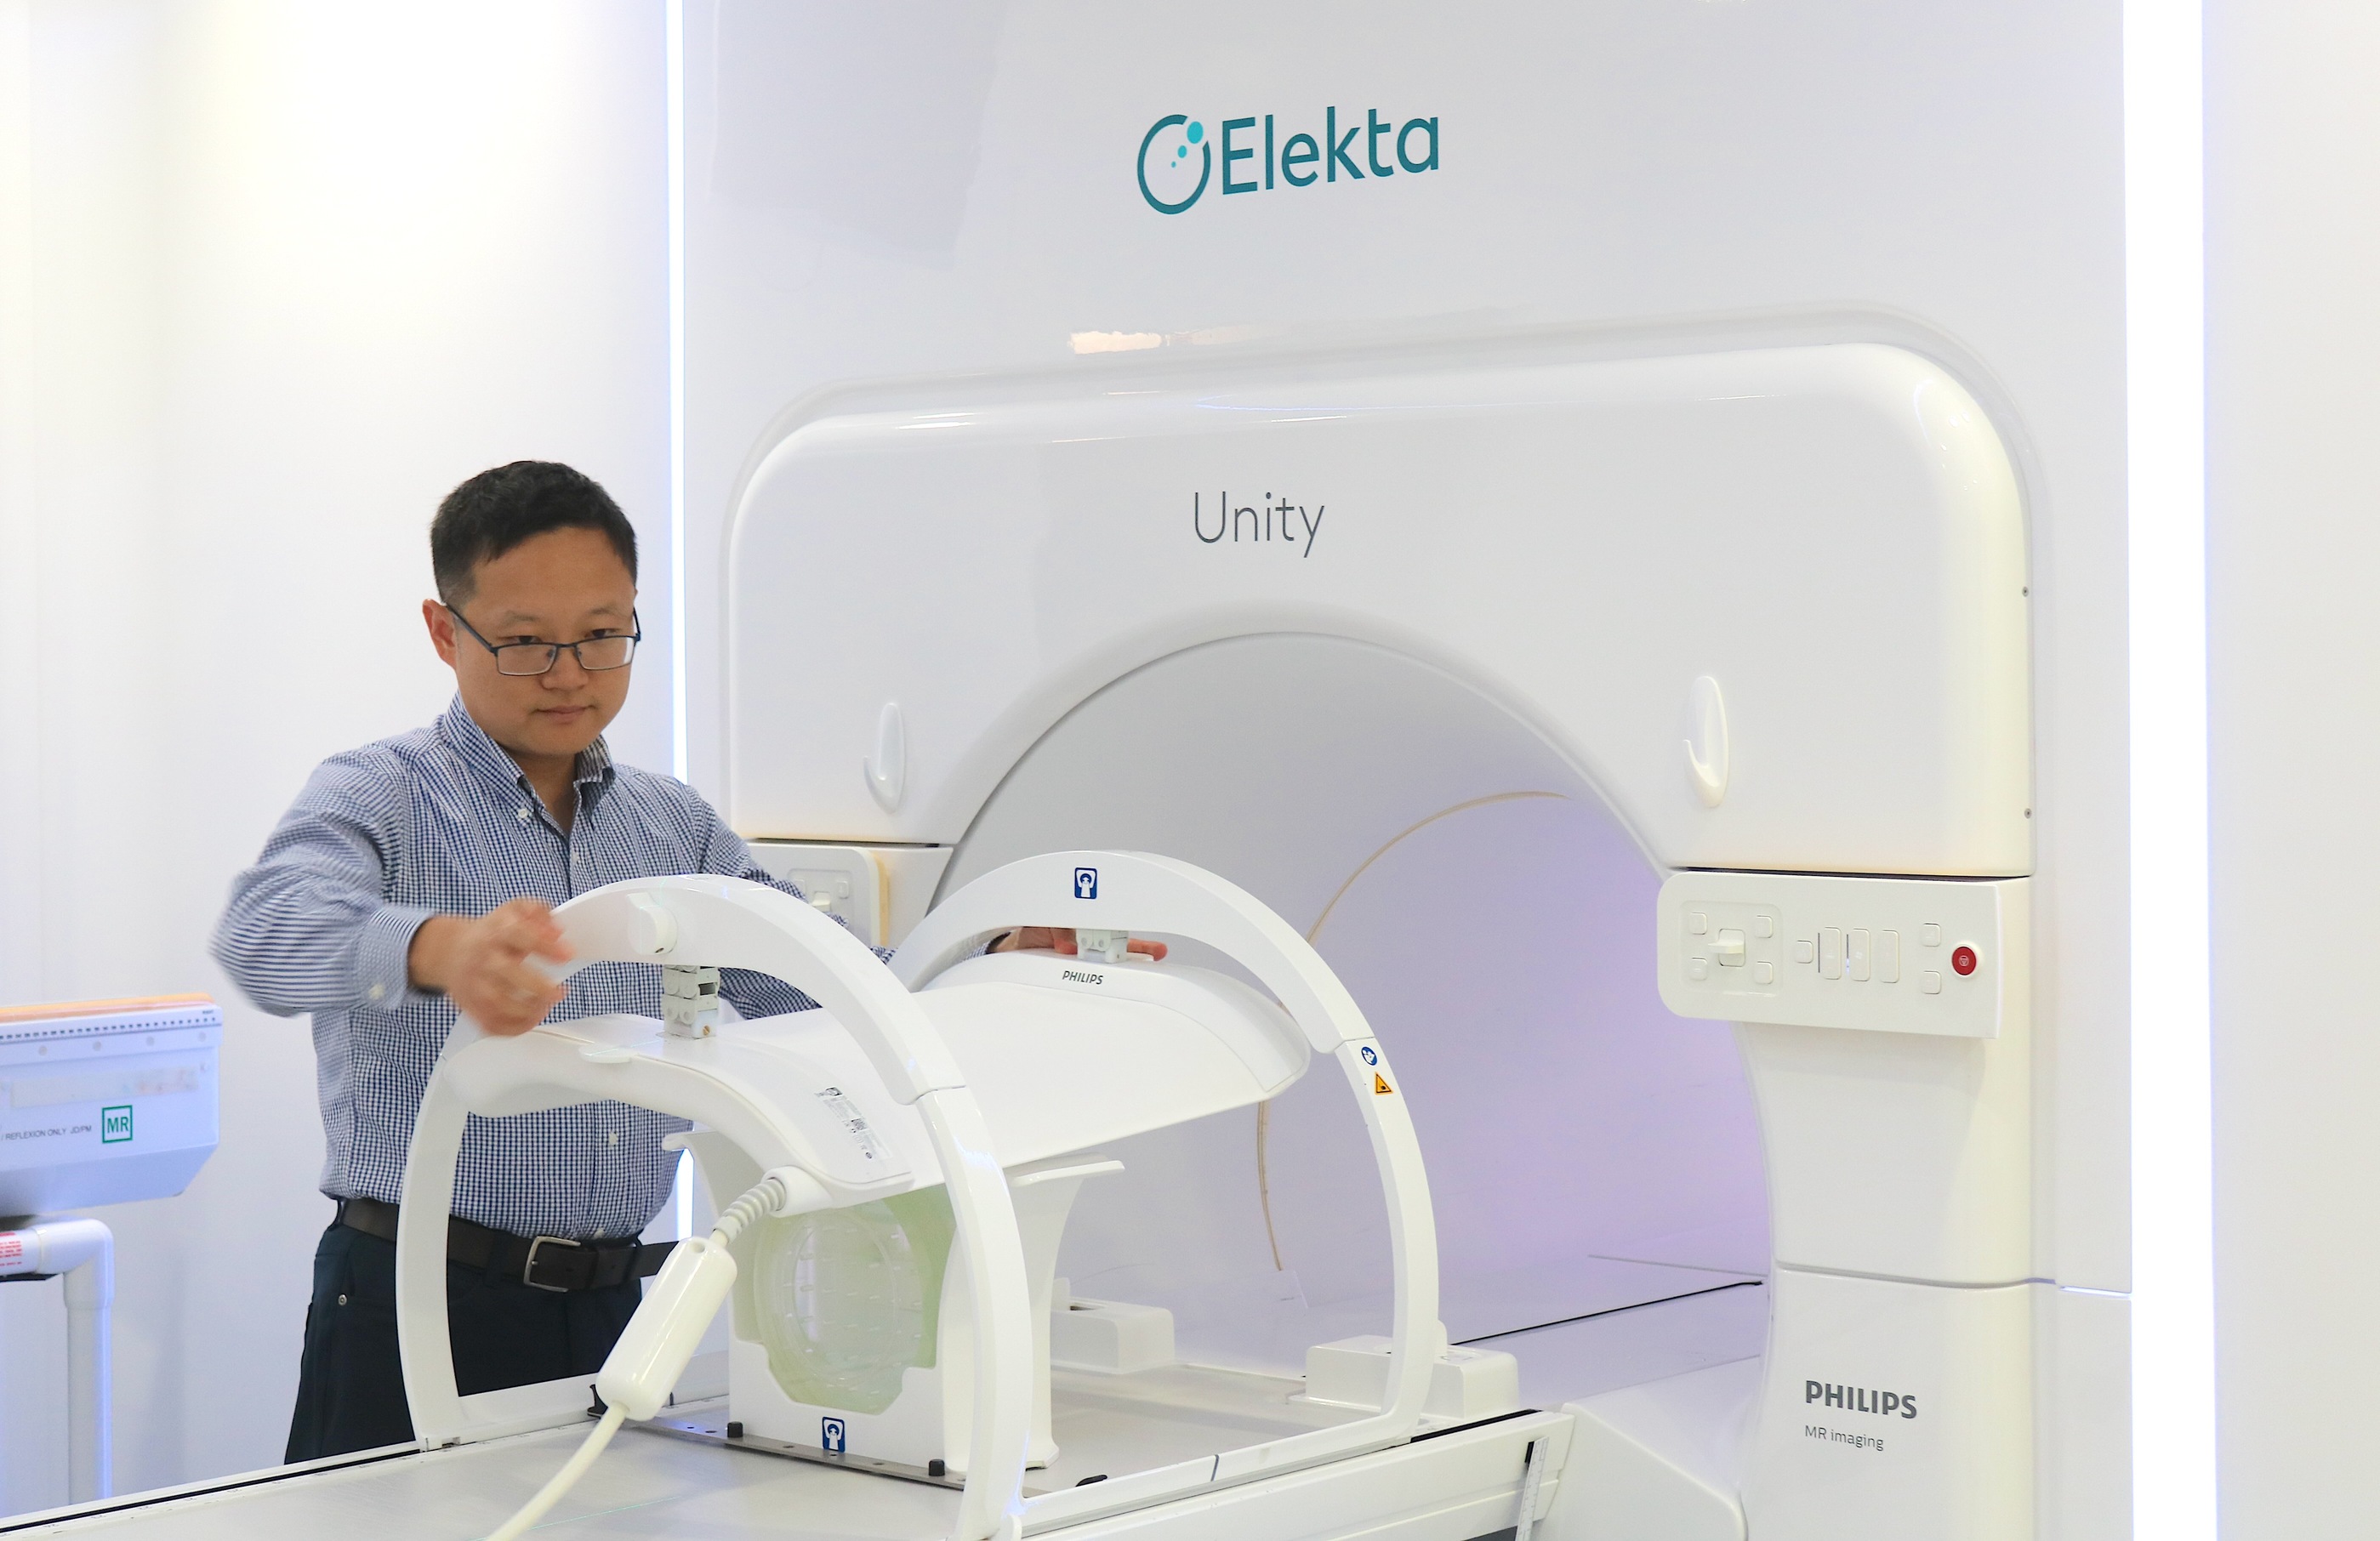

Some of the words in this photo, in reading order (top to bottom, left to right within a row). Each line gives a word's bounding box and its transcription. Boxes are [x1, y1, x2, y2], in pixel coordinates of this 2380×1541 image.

[1221, 105, 1439, 196] Elekta
[1194, 491, 1325, 558] Unity
[1062, 970, 1104, 985] PHILIPS
[5, 1129, 46, 1140] REFLEXION
[47, 1128, 66, 1137] ONLY
[107, 1116, 129, 1134] MR
[1805, 1379, 1918, 1419] PHILIPS
[1805, 1424, 1827, 1440] MR
[1831, 1429, 1884, 1452] imaging
